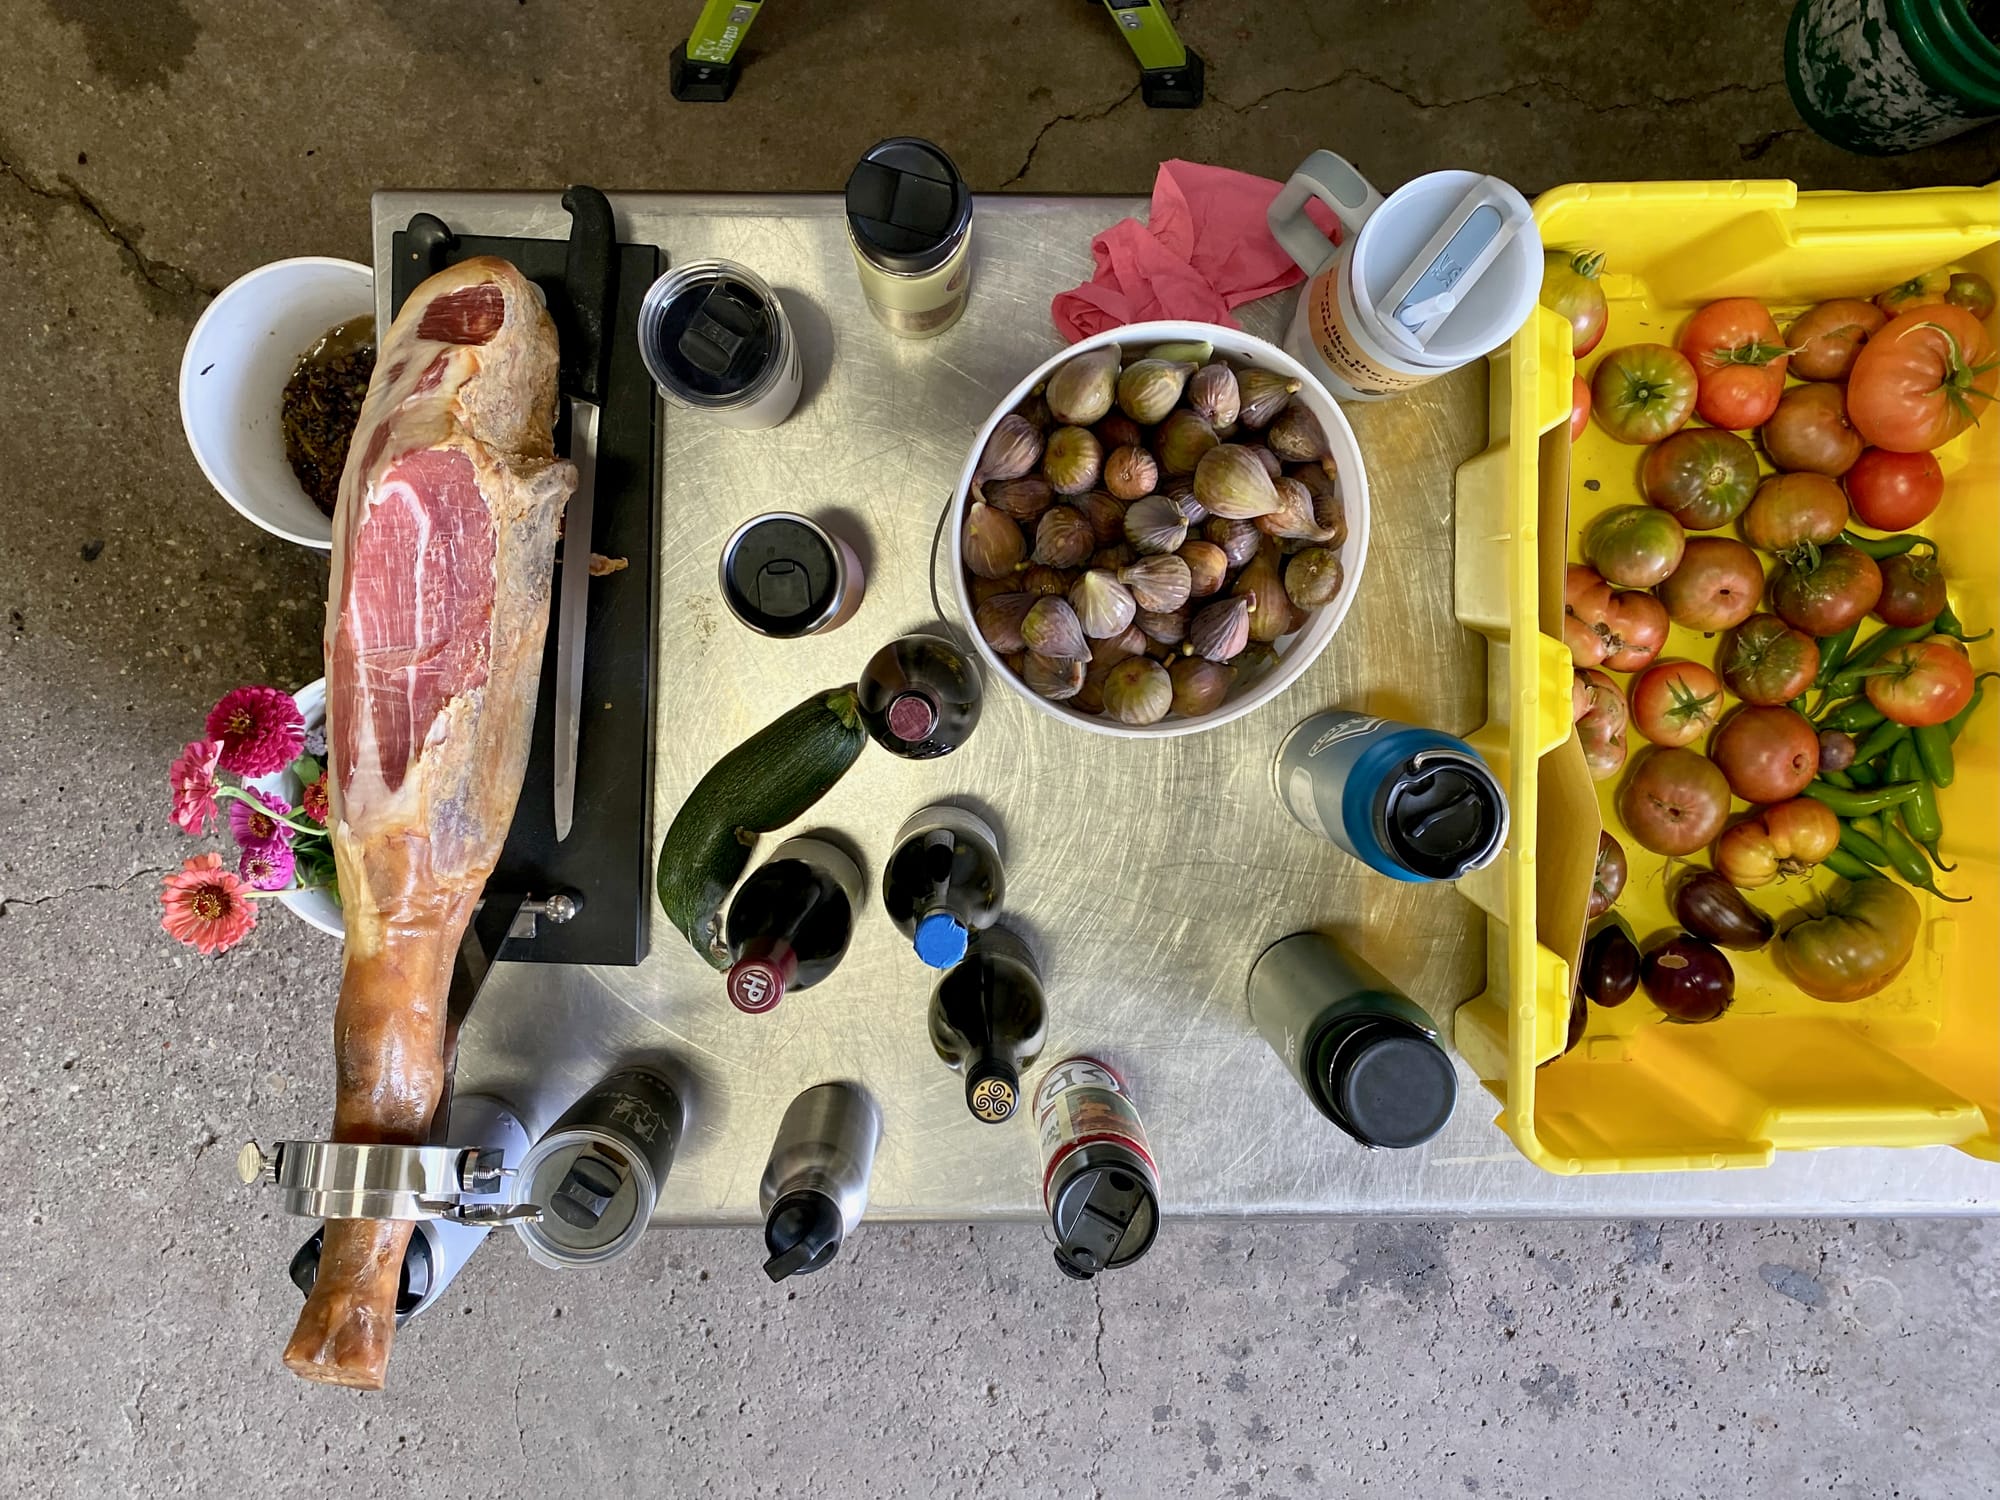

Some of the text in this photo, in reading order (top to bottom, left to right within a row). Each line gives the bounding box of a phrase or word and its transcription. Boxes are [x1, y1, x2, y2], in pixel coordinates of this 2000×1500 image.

[1320, 300, 1362, 374] depends
[1367, 375, 1390, 385] on
[1331, 324, 1350, 356] like
[1355, 360, 1382, 377] the
